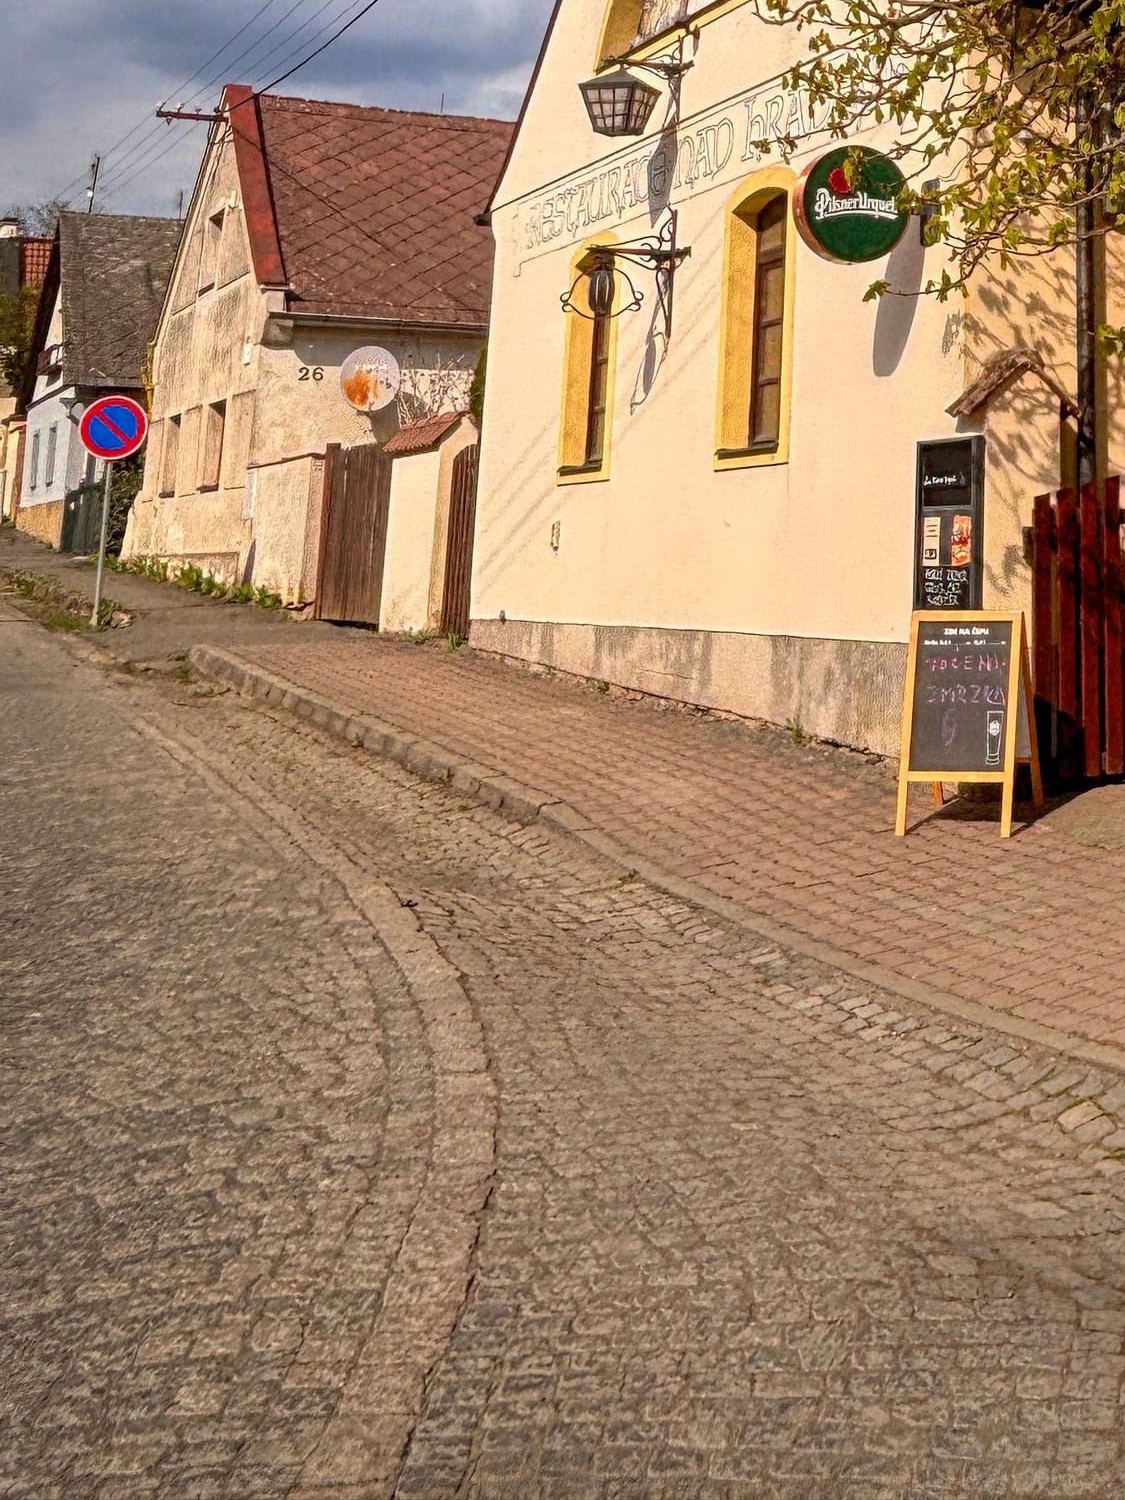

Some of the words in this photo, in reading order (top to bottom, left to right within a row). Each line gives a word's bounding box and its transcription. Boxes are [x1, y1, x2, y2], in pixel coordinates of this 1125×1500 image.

[673, 118, 735, 190] NAD
[814, 187, 859, 220] Pilsner
[298, 366, 324, 381] 26
